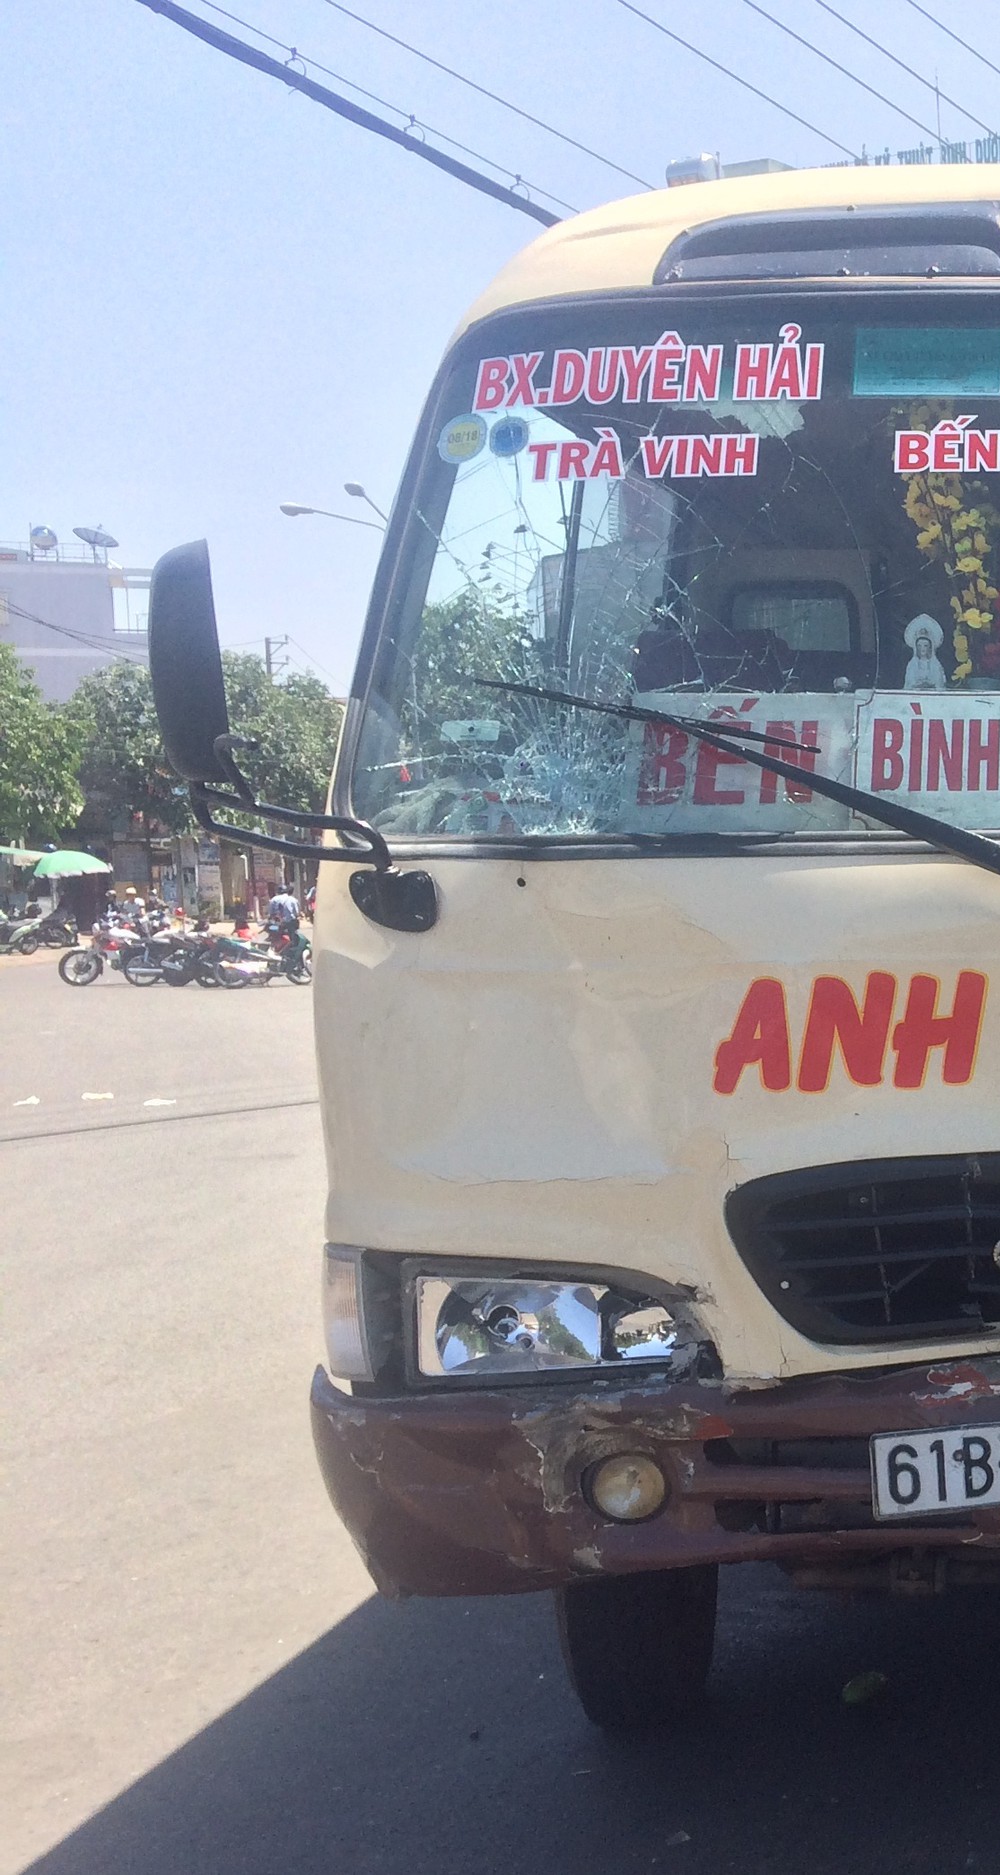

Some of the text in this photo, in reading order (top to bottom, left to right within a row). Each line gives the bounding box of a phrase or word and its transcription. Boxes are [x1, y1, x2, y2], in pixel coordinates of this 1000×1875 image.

[473, 330, 724, 413] BX.DUYÊN
[733, 323, 824, 401] HẢI
[529, 427, 759, 482] TRÀ VINH
[894, 415, 1000, 473] BẾN
[636, 697, 819, 805] BẾN
[871, 703, 1000, 792] BÌNH
[712, 969, 988, 1095] ANH
